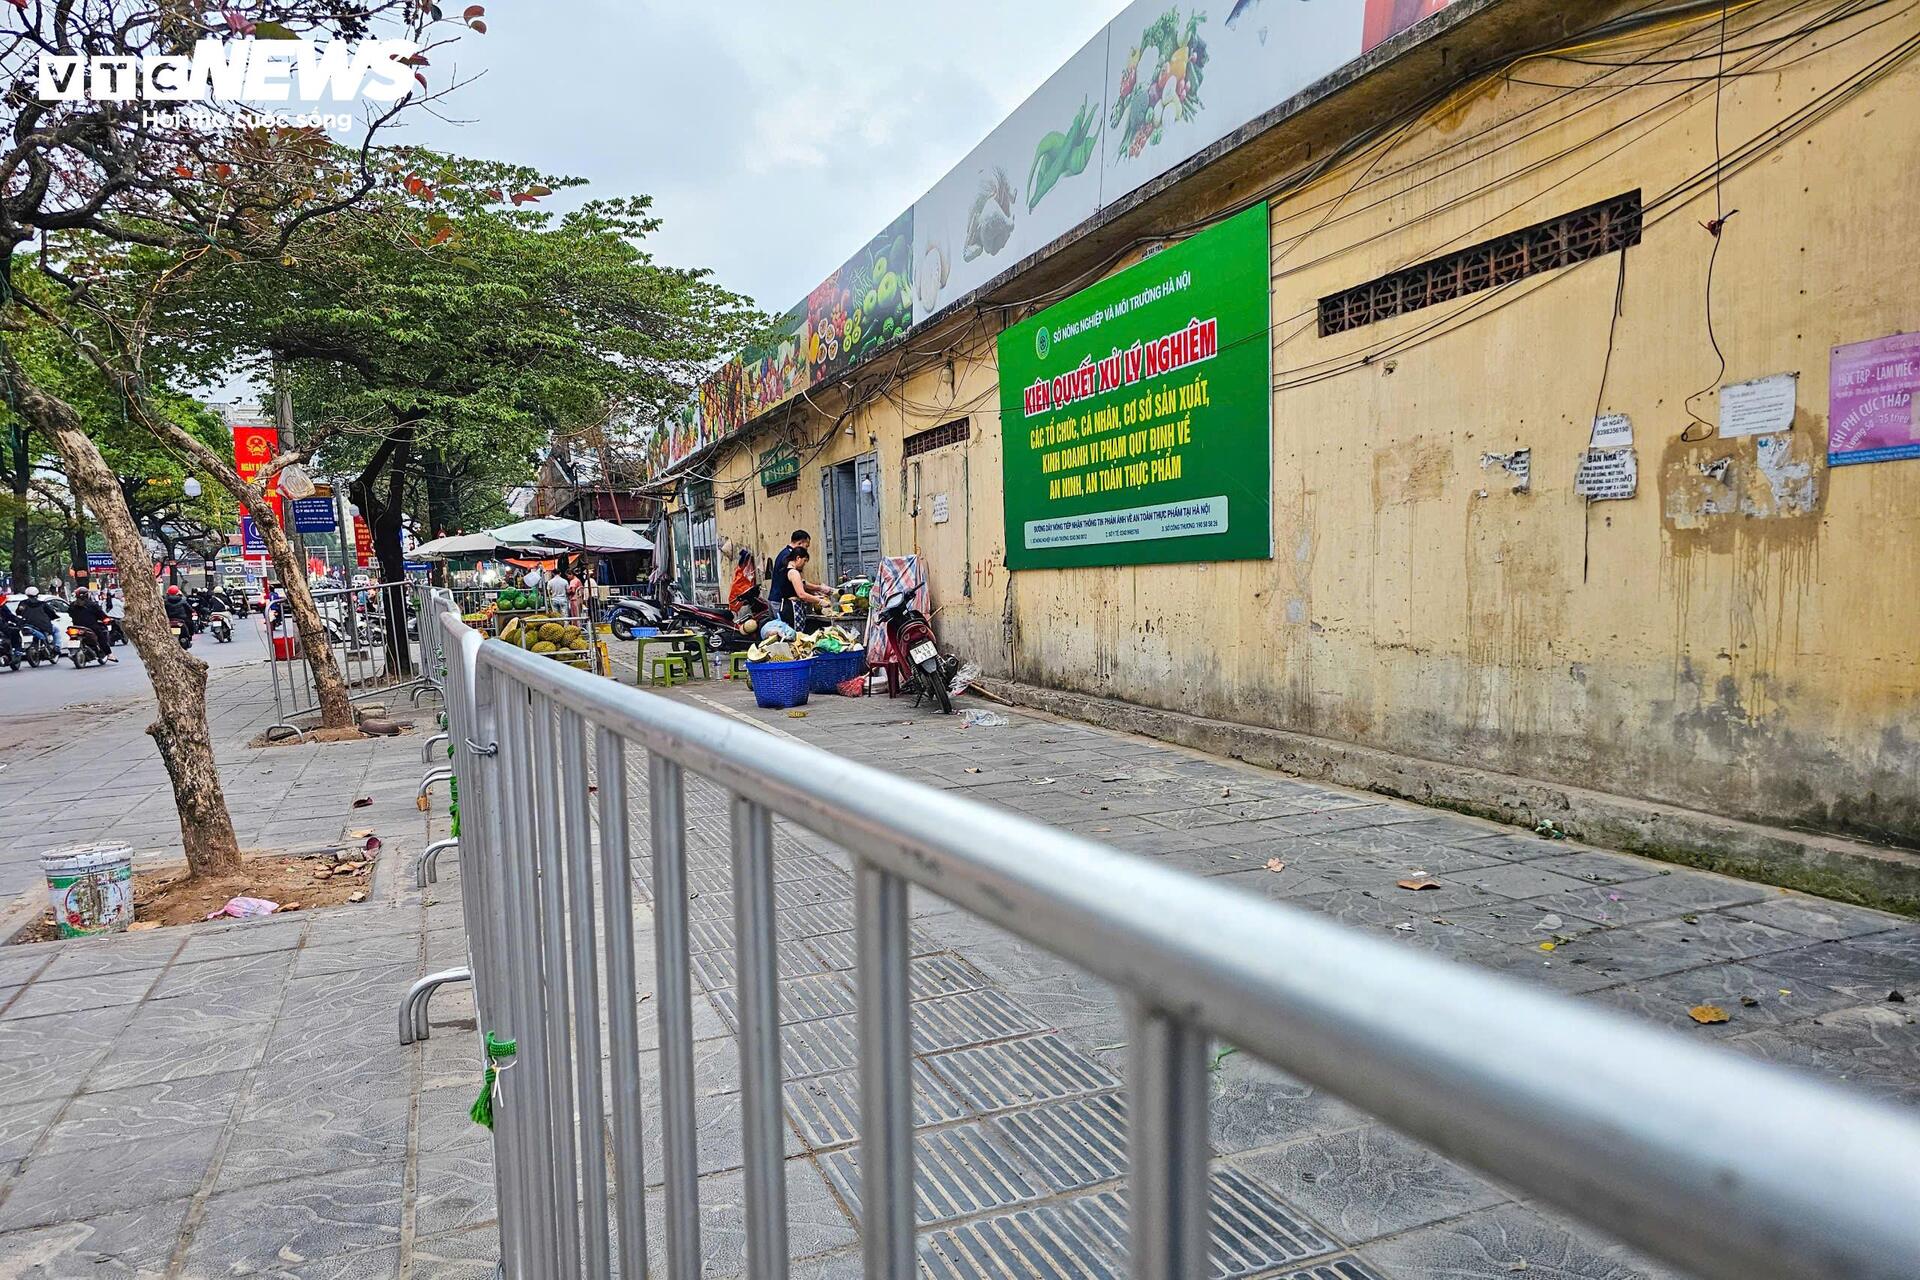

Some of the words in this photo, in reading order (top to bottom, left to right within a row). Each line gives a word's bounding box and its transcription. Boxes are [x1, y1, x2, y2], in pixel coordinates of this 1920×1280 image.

[1053, 327, 1063, 344] SỞ
[1062, 322, 1079, 341] NÔNG
[1079, 311, 1103, 332] NGHIỆP
[1104, 306, 1115, 322] VÀ
[1115, 300, 1129, 317] MÔI
[1129, 285, 1161, 311] TRƯỜNG
[1162, 280, 1175, 296] HÀ
[1175, 270, 1191, 293] NỘI
[1024, 376, 1050, 418] KIÊN
[1052, 353, 1096, 410] QUYẾT
[1098, 347, 1123, 394] XỬ
[1124, 339, 1143, 385] LÝ
[1145, 316, 1217, 378] NGHIÊM
[1876, 362, 1894, 380] LÀM
[1895, 359, 1913, 380] VIỆC
[1030, 425, 1044, 449] CÁC
[1045, 416, 1055, 445] TỔ
[1056, 416, 1079, 443] CHỨC,
[1080, 413, 1092, 437] CÁ
[1094, 404, 1122, 433] NHÂN,
[1123, 398, 1138, 425] CƠ
[1139, 389, 1153, 422] SỞ
[1154, 384, 1176, 418] SẢN
[1179, 372, 1210, 411] XUẤT,
[1830, 429, 1847, 449] CHI
[1841, 408, 1860, 431] PHÍ
[1859, 397, 1880, 417] CỰC
[1880, 389, 1910, 408] THẤP
[1042, 452, 1060, 474] KINH
[1061, 444, 1089, 470] DOANH
[1089, 441, 1099, 463] VI
[1100, 435, 1127, 463] PHẠM
[1128, 430, 1148, 458] QUY
[1150, 422, 1175, 455] ĐỊNH
[1177, 411, 1191, 445] VỀ
[1049, 478, 1060, 500] AN
[1062, 473, 1084, 498] NINH,
[1086, 471, 1098, 494] AN
[1099, 462, 1123, 491] TOÀN
[1124, 460, 1148, 491] THỰC
[1151, 448, 1182, 483] PHẨM
[1140, 510, 1153, 521] TOÀN
[1153, 510, 1167, 521] THỰC
[1167, 506, 1183, 518] PHẨM
[1183, 507, 1192, 517] TẠI
[1192, 504, 1200, 515] HÀ
[1200, 503, 1210, 515] NỘI
